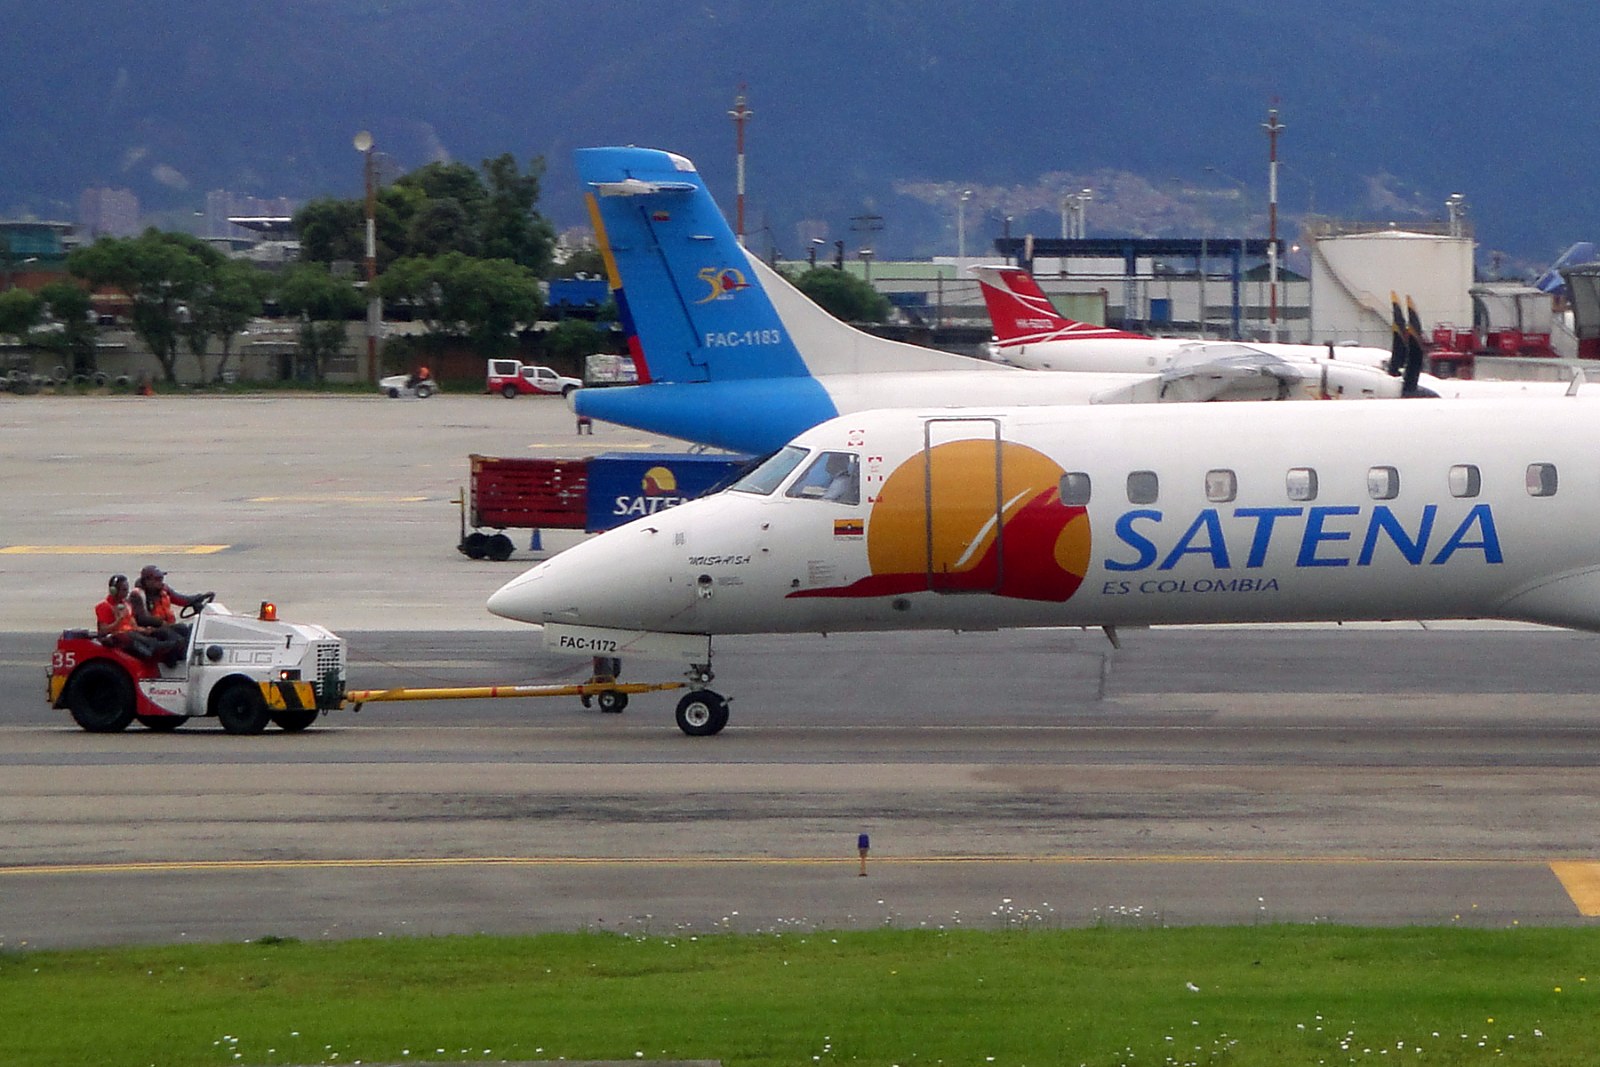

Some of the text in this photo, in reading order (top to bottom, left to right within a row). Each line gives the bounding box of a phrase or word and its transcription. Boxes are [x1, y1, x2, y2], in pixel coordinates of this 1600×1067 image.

[705, 329, 780, 348] FAC-1183
[1104, 504, 1504, 572] SATENA
[1102, 578, 1280, 595] ES COLOMBIA
[560, 636, 617, 652] FAC-1172
[52, 652, 76, 668] 35
